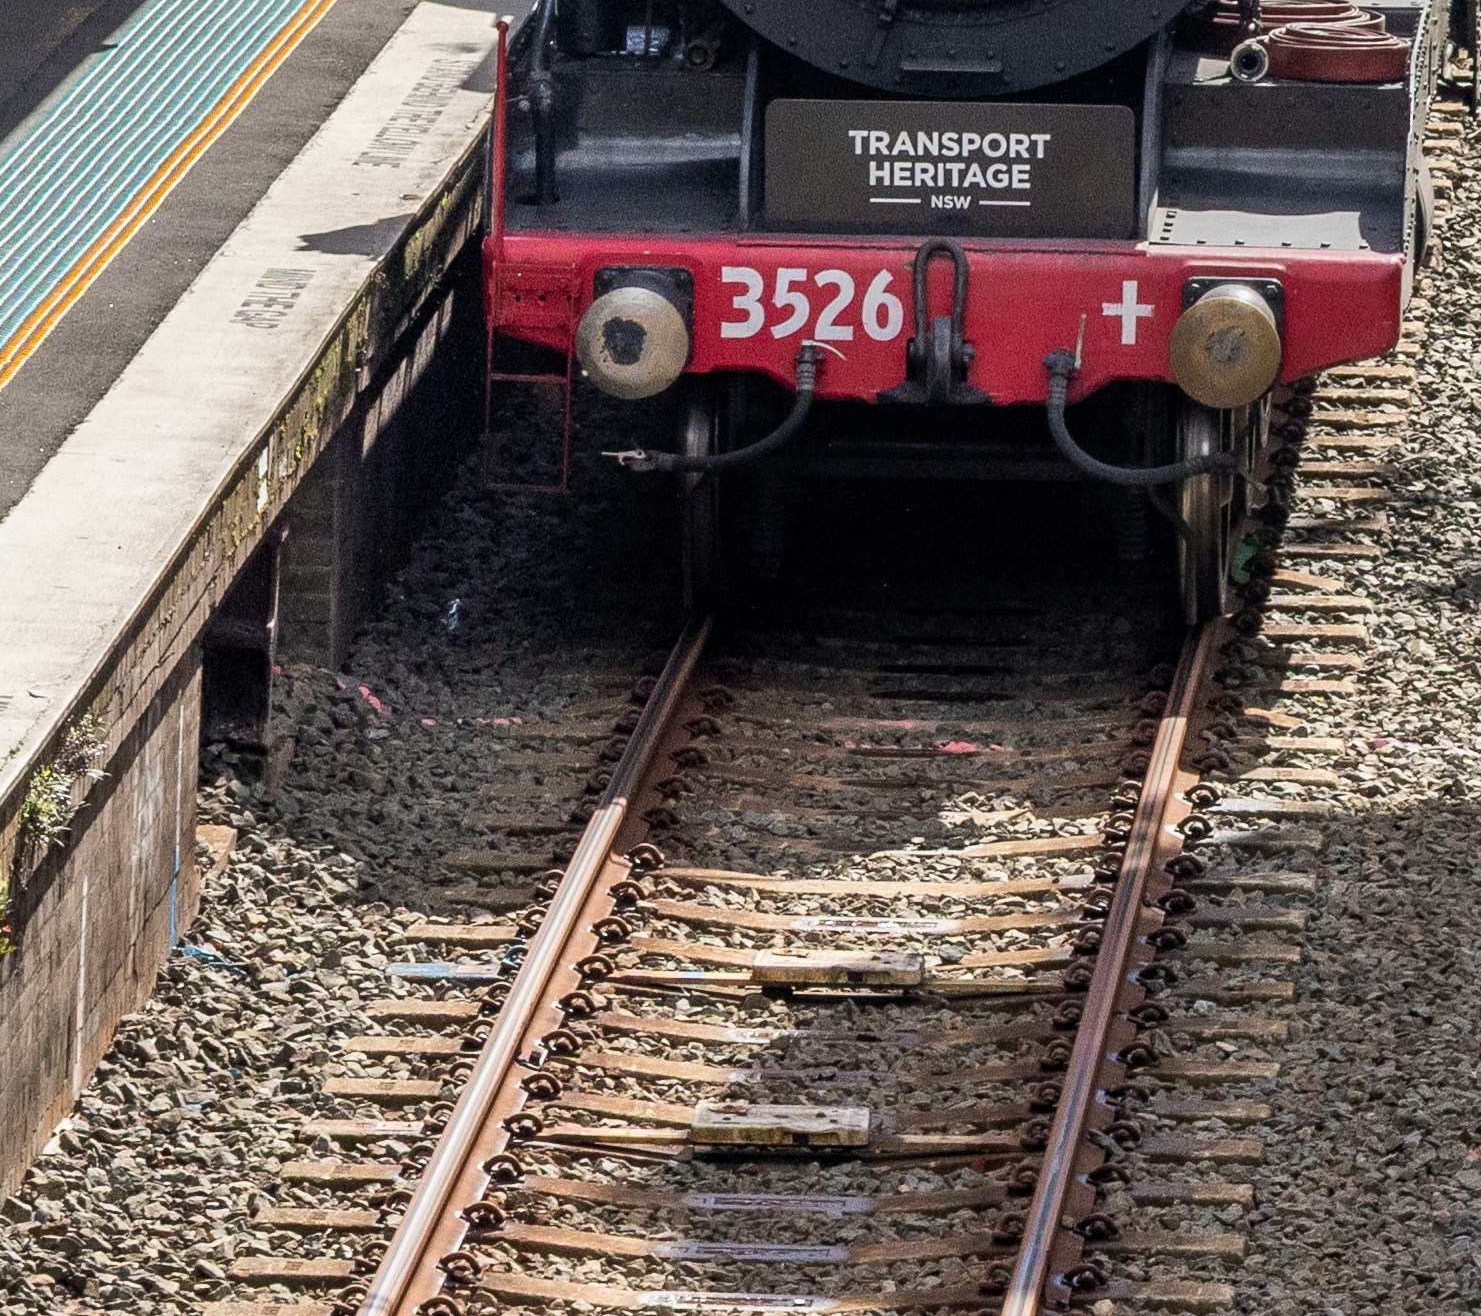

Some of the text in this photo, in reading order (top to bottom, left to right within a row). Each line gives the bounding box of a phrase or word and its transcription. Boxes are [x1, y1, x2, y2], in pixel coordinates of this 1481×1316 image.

[848, 130, 1051, 159] TRANSPORT
[869, 160, 1031, 189] HERITAGE
[931, 194, 972, 210] NSW
[721, 266, 903, 341] 3526
